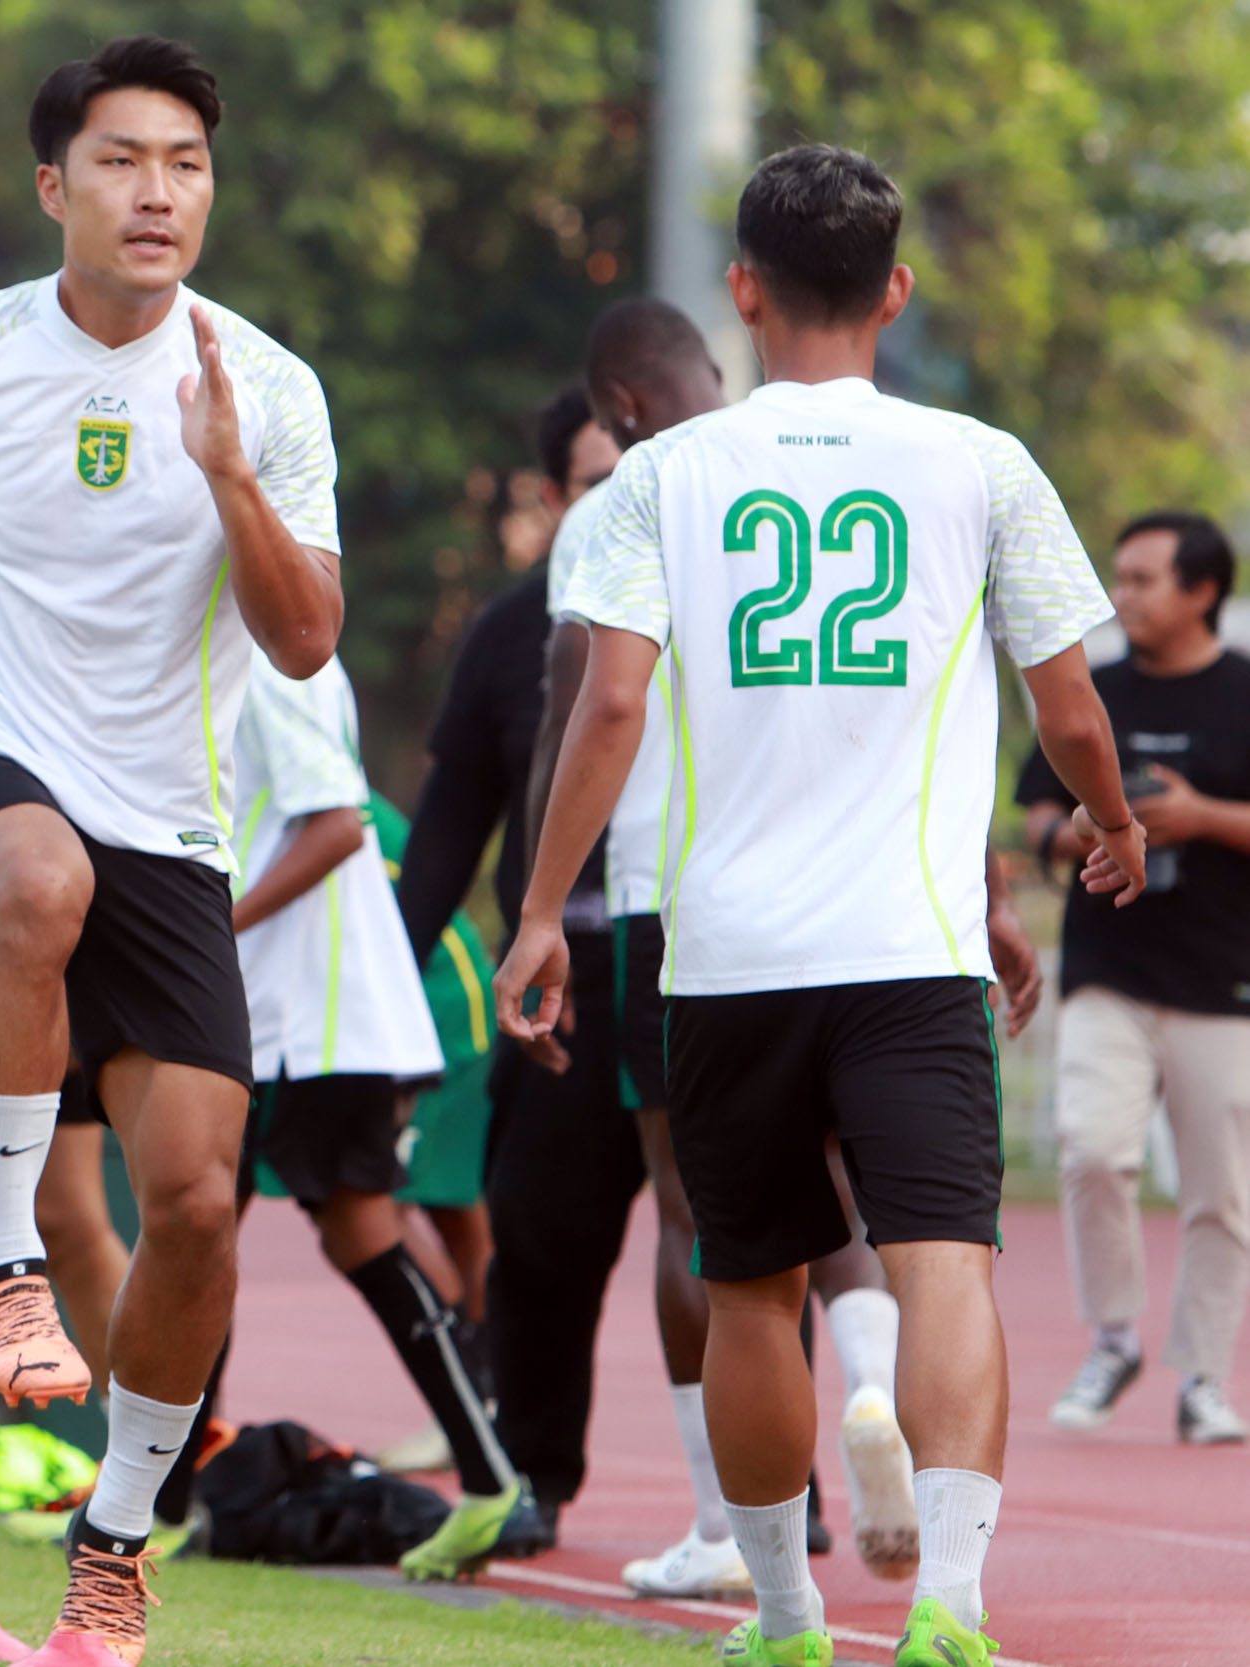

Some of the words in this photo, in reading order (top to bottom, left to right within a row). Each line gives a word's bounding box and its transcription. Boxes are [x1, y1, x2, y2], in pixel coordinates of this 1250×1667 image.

[778, 434, 813, 446] GREEN
[817, 434, 851, 446] FORCE
[723, 489, 908, 688] 22
